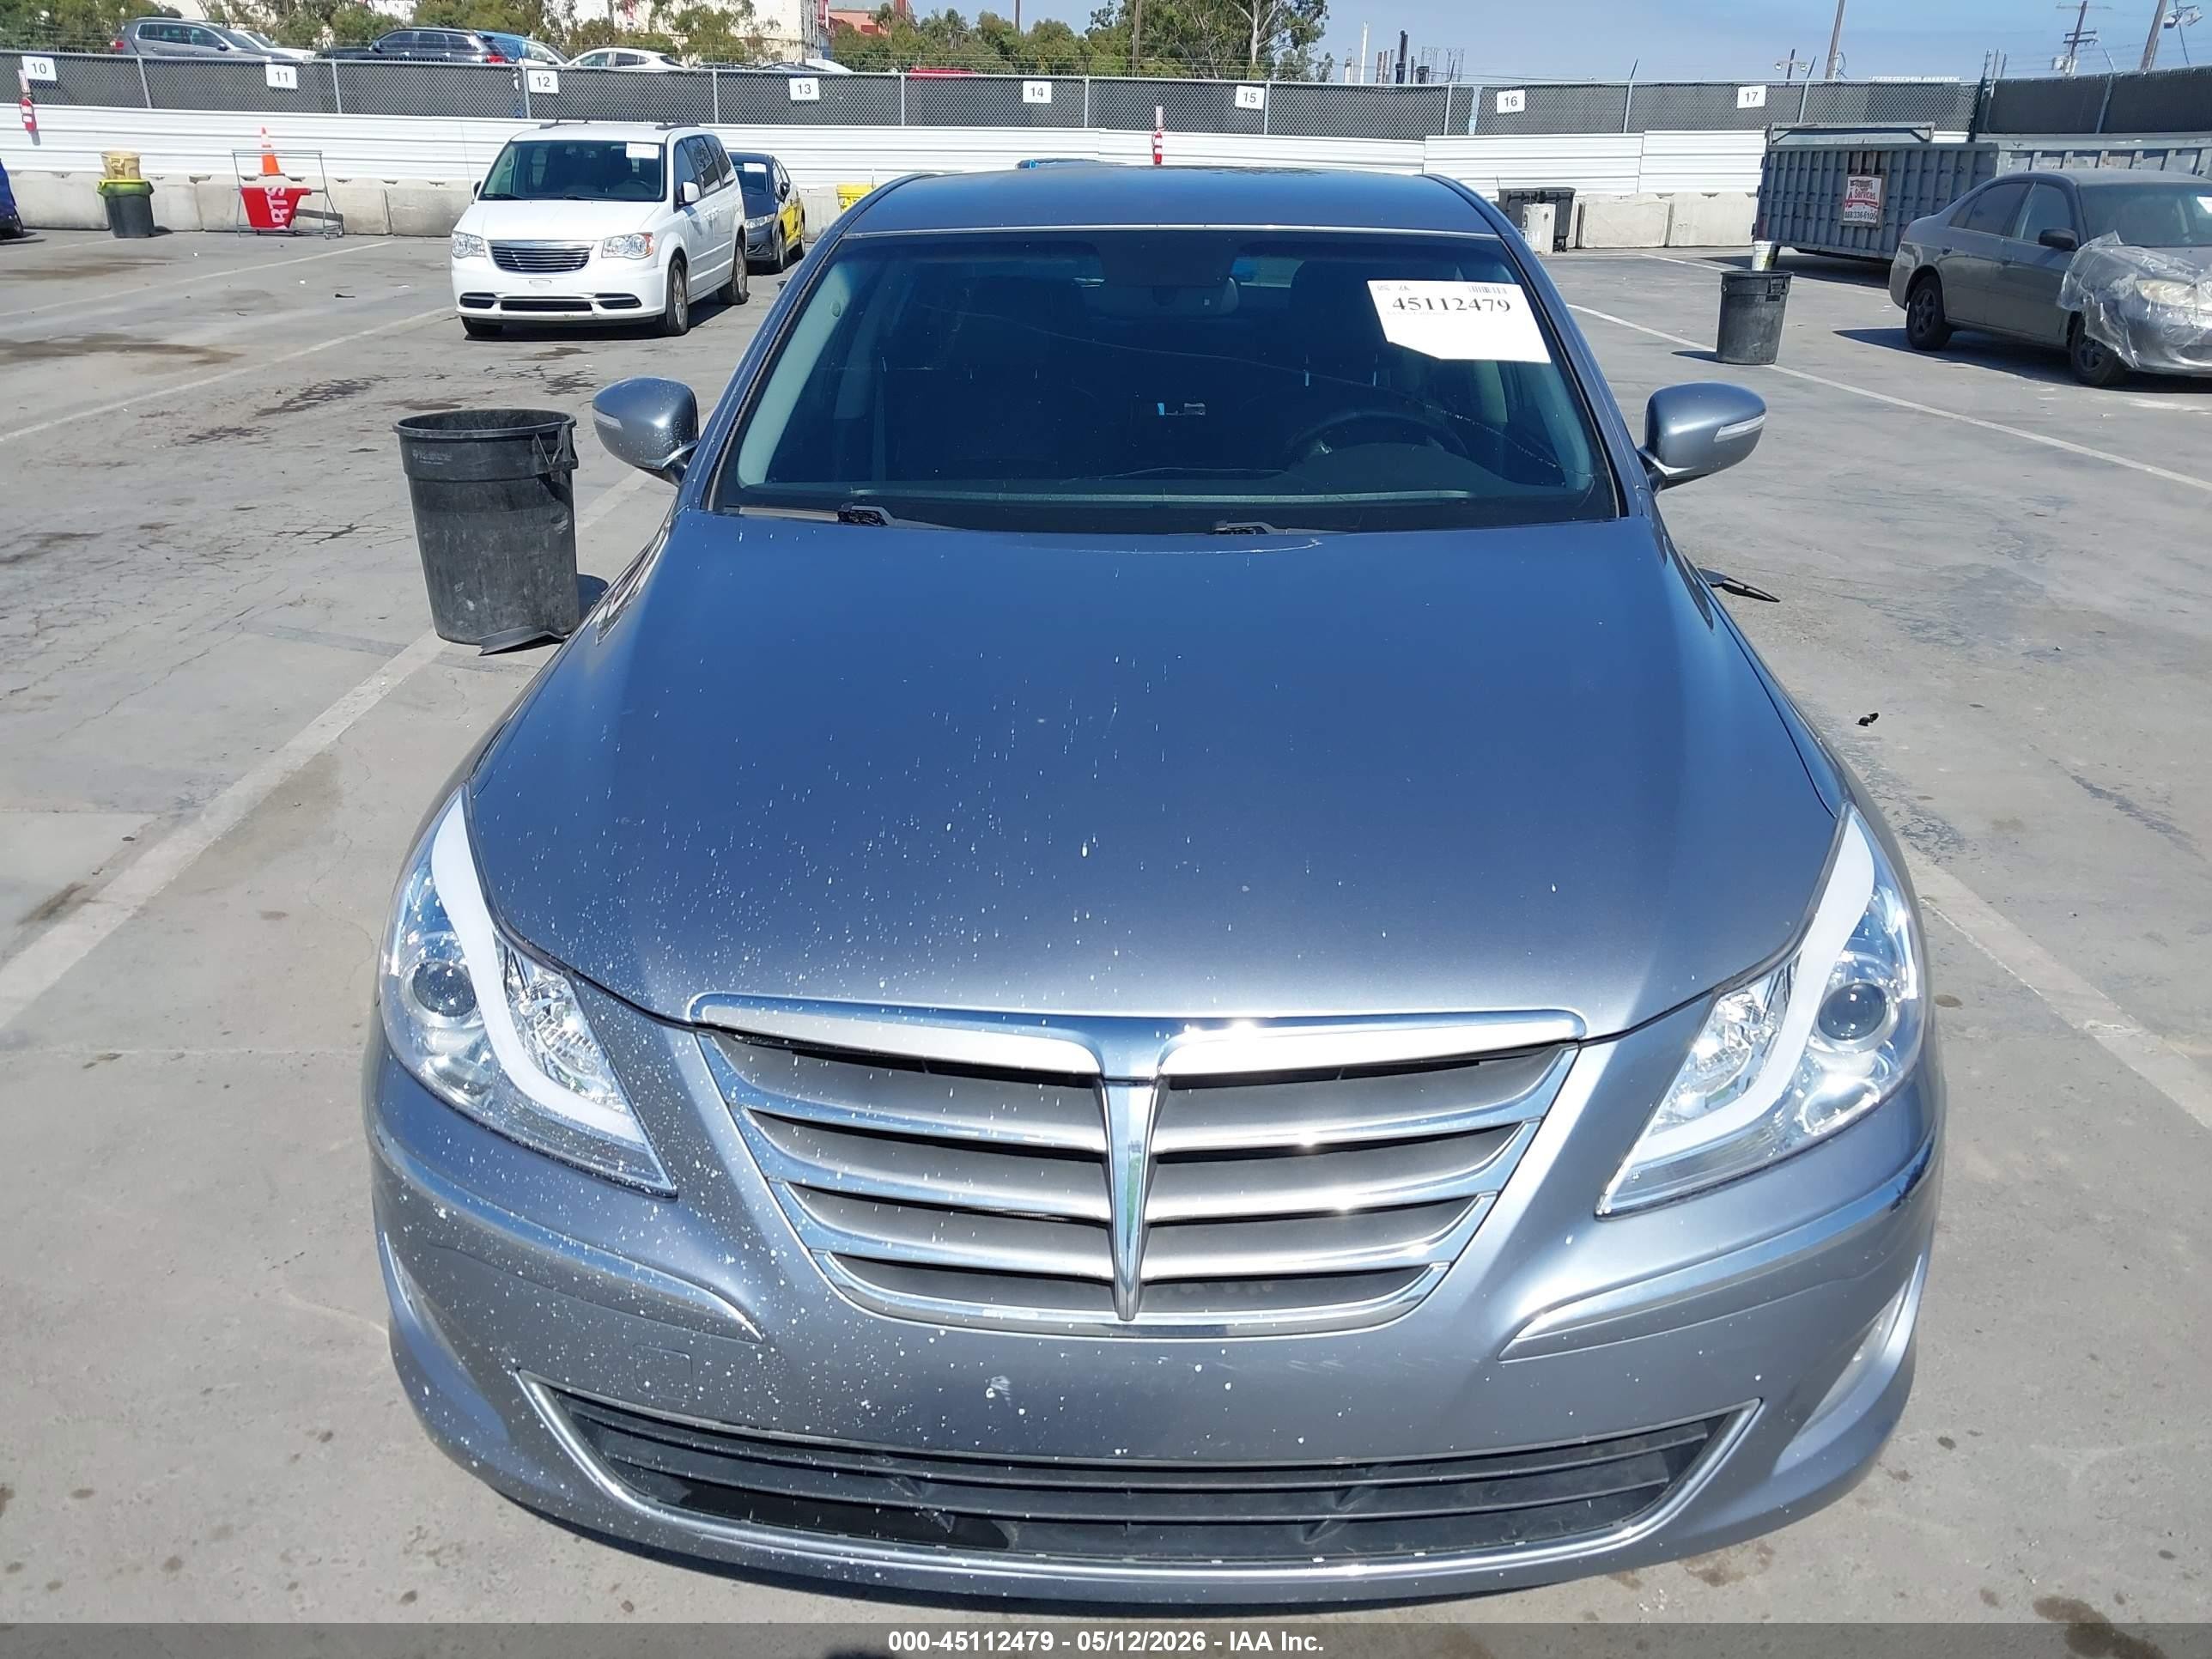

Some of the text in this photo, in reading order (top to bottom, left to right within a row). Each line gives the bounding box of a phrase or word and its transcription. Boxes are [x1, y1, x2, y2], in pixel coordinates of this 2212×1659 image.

[31, 62, 47, 75] 10
[275, 70, 289, 83] 11
[536, 76, 550, 88] 12
[797, 83, 811, 94] 13
[1030, 87, 1044, 98] 14
[1243, 92, 1256, 103] 15
[1504, 96, 1518, 107] 16
[1745, 92, 1758, 102] 17
[264, 186, 289, 228] RTS
[1392, 296, 1511, 313] 45112479
